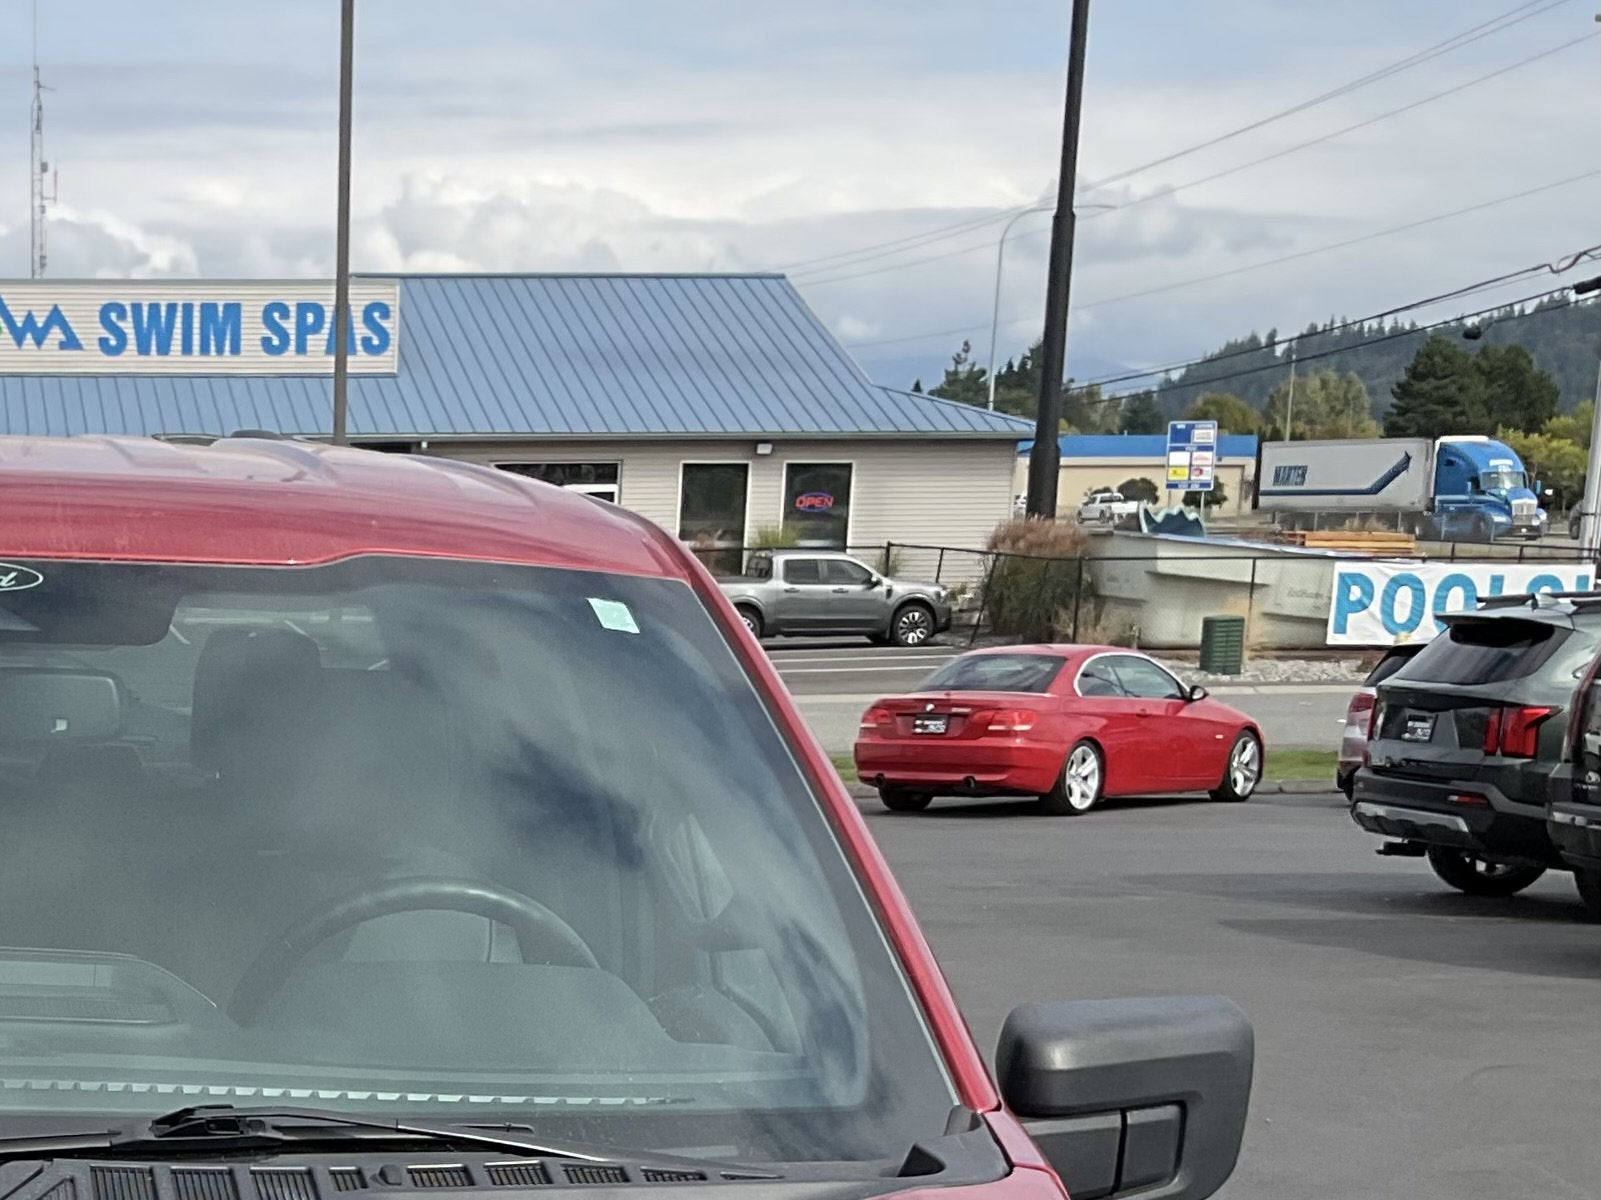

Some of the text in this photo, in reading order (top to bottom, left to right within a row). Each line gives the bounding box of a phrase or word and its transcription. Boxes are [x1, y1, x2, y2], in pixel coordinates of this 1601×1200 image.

[98, 301, 243, 356] SWIM
[795, 496, 834, 508] OPEN
[1333, 572, 1591, 636] POO
